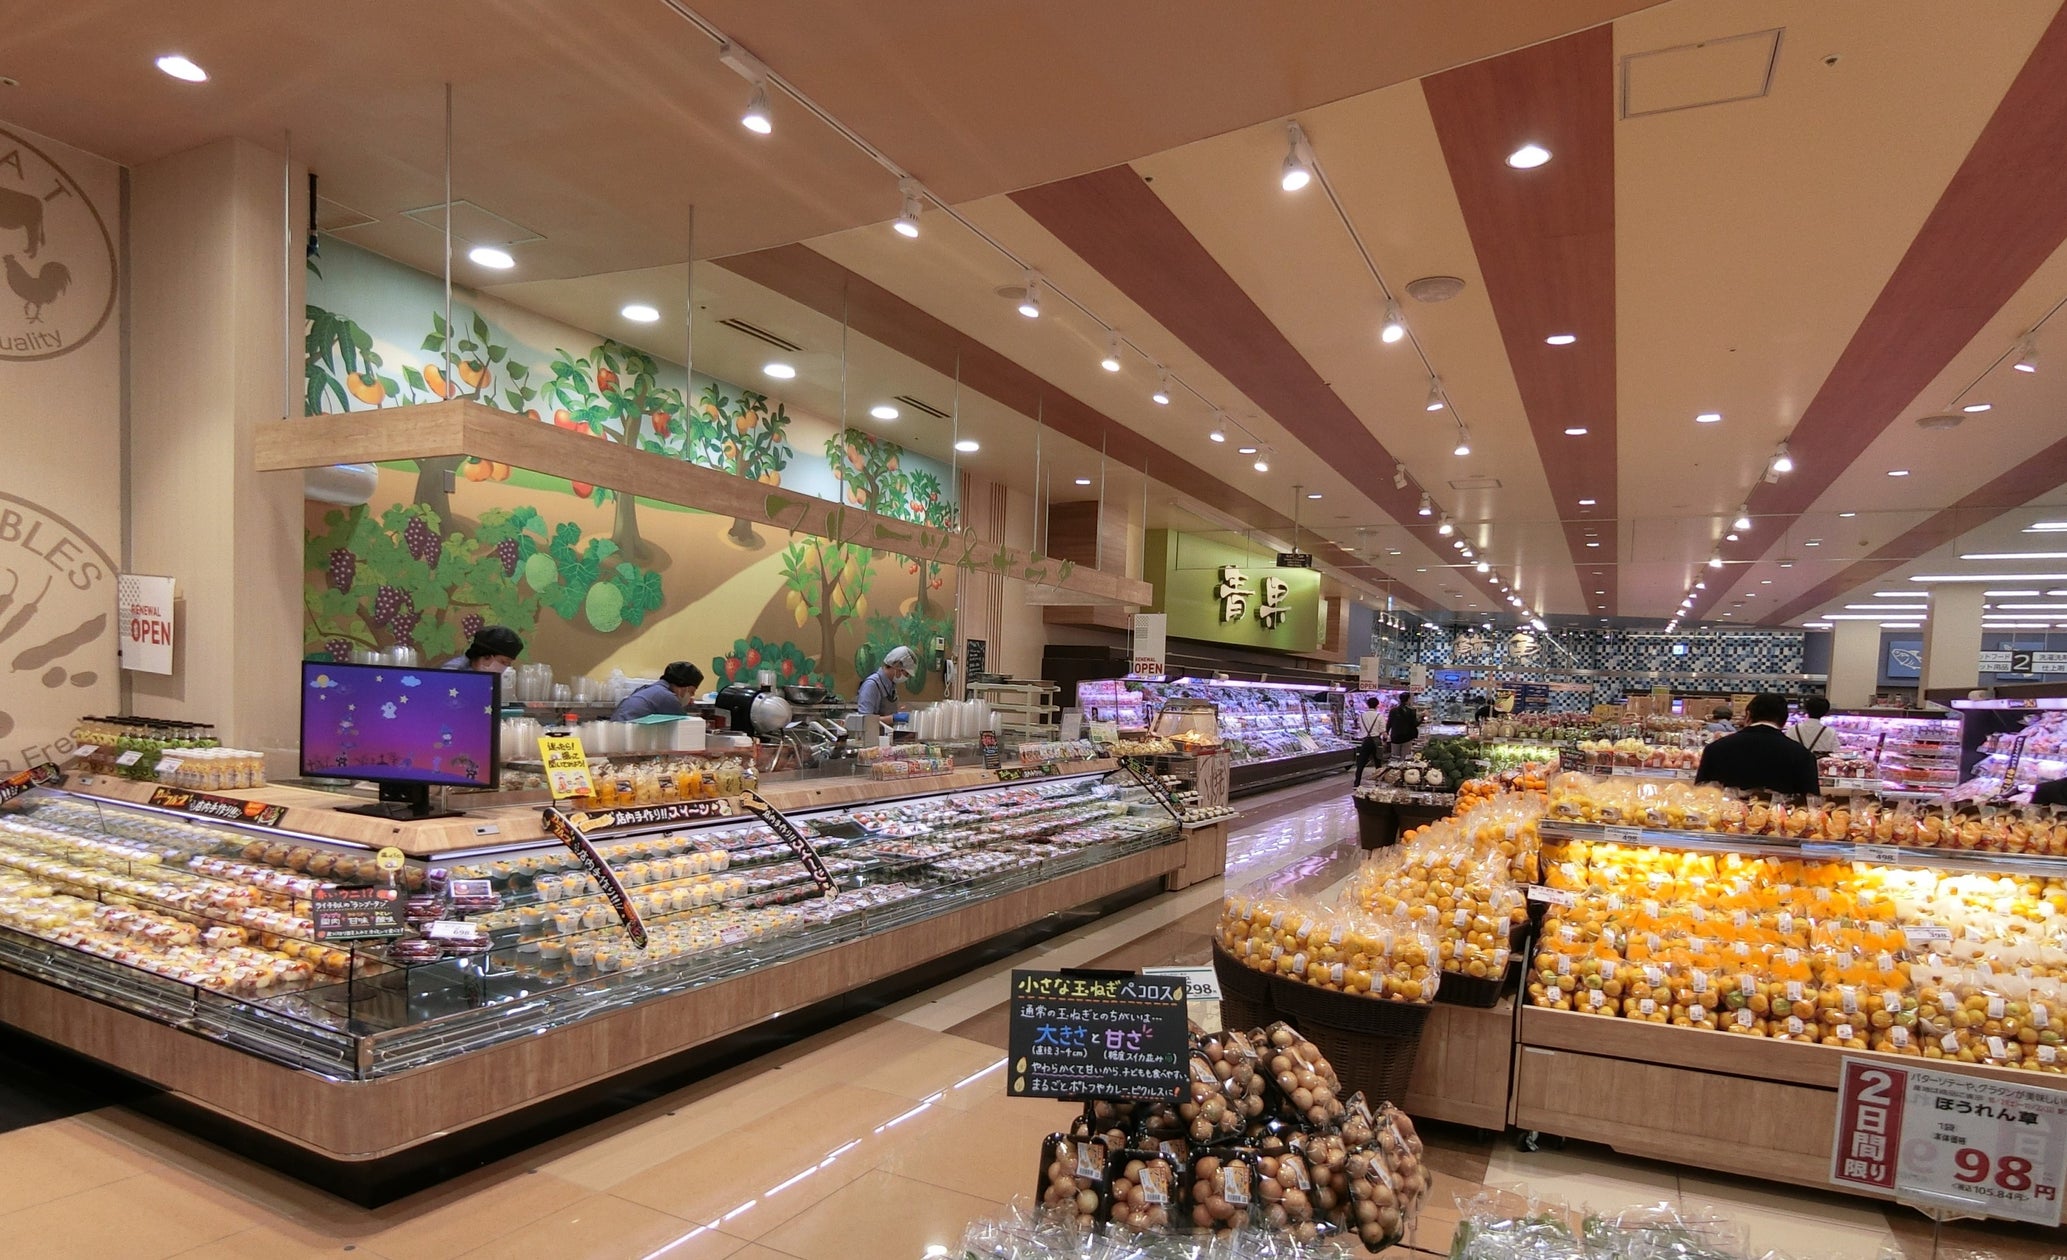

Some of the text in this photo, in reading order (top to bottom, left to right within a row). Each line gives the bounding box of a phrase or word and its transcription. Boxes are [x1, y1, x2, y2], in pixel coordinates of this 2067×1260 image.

[131, 603, 162, 617] RENEWAL
[1214, 565, 1292, 630] 青果
[131, 618, 171, 646] OPEN
[1134, 662, 1163, 674] OPEN
[2013, 654, 2031, 671] 2
[1034, 1023, 1142, 1050] 大きさ と 甘さ
[1935, 1096, 2039, 1125] ほうれん草
[1844, 1070, 1892, 1182] 2日間限り
